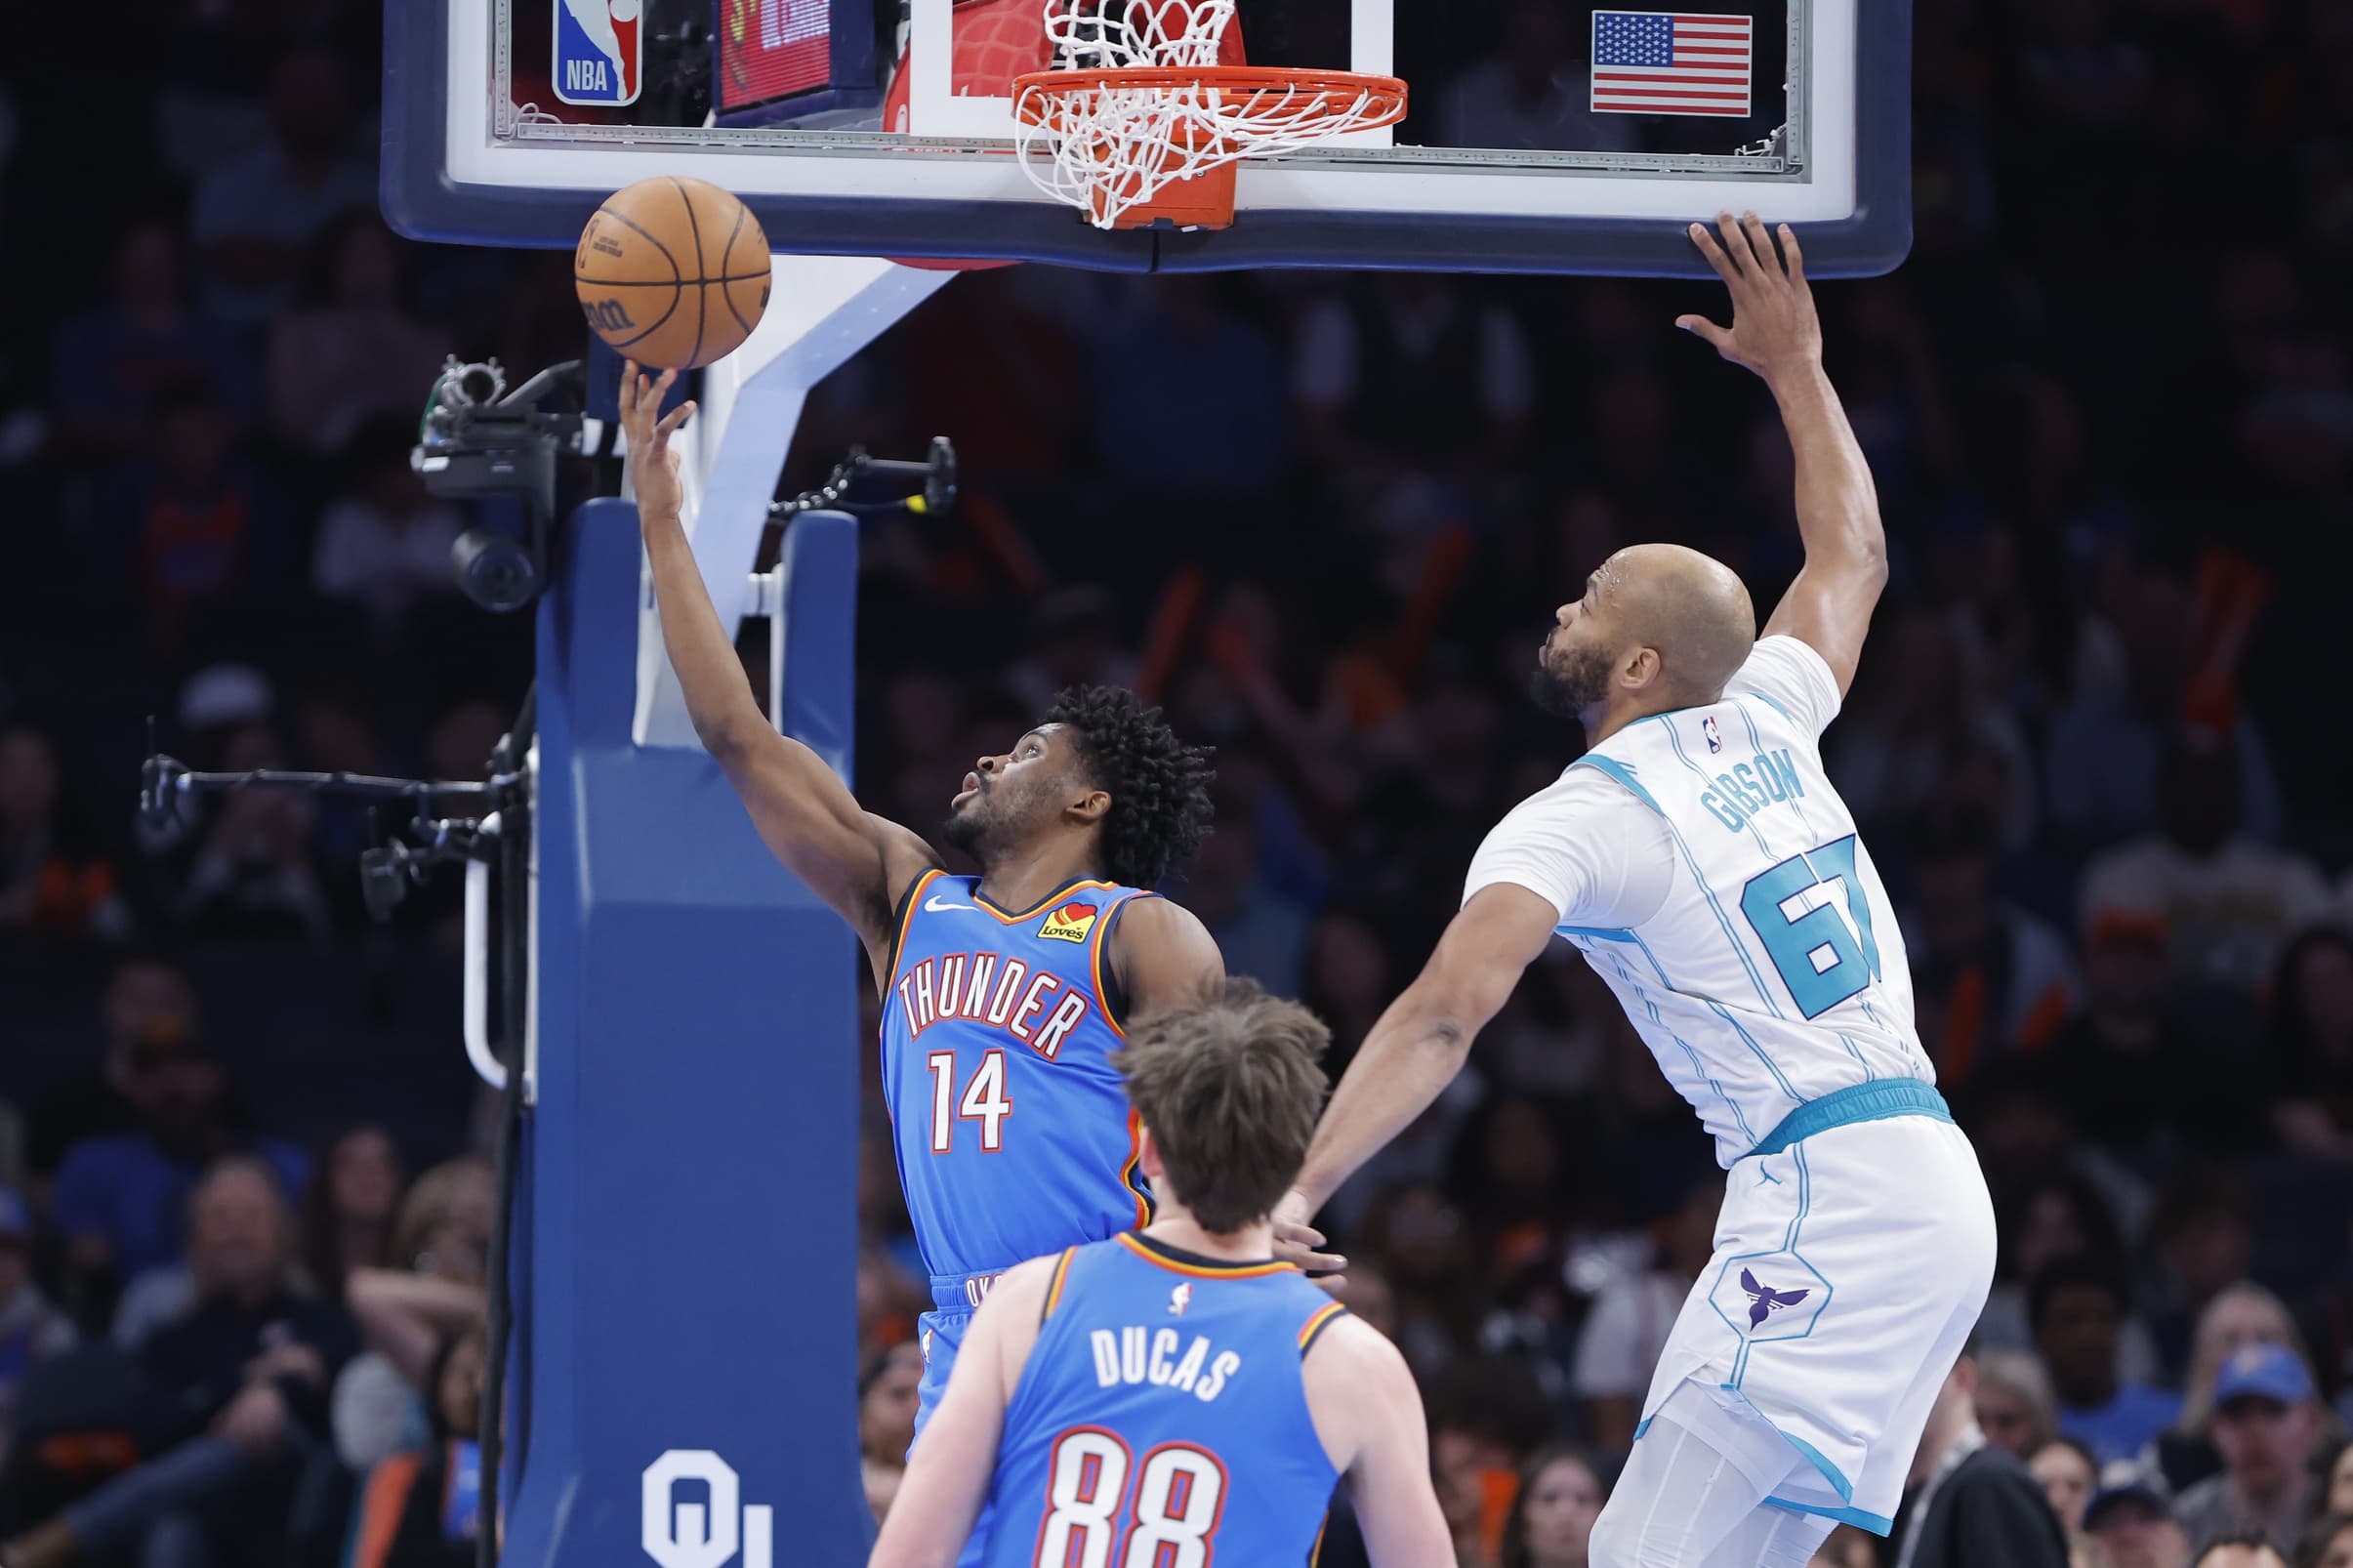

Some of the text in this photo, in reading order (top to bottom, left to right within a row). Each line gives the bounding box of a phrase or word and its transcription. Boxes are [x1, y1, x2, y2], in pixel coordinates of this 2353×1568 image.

[566, 59, 608, 92] NBA
[1701, 749, 1804, 833] GIBSON
[1041, 926, 1085, 939] Love's
[1740, 833, 1881, 1020] 67
[898, 951, 1090, 1062] THUNDER
[928, 1048, 1013, 1154] 14
[965, 1273, 1004, 1309] OK
[1091, 1326, 1240, 1402] DUCAS
[1032, 1424, 1230, 1568] 88
